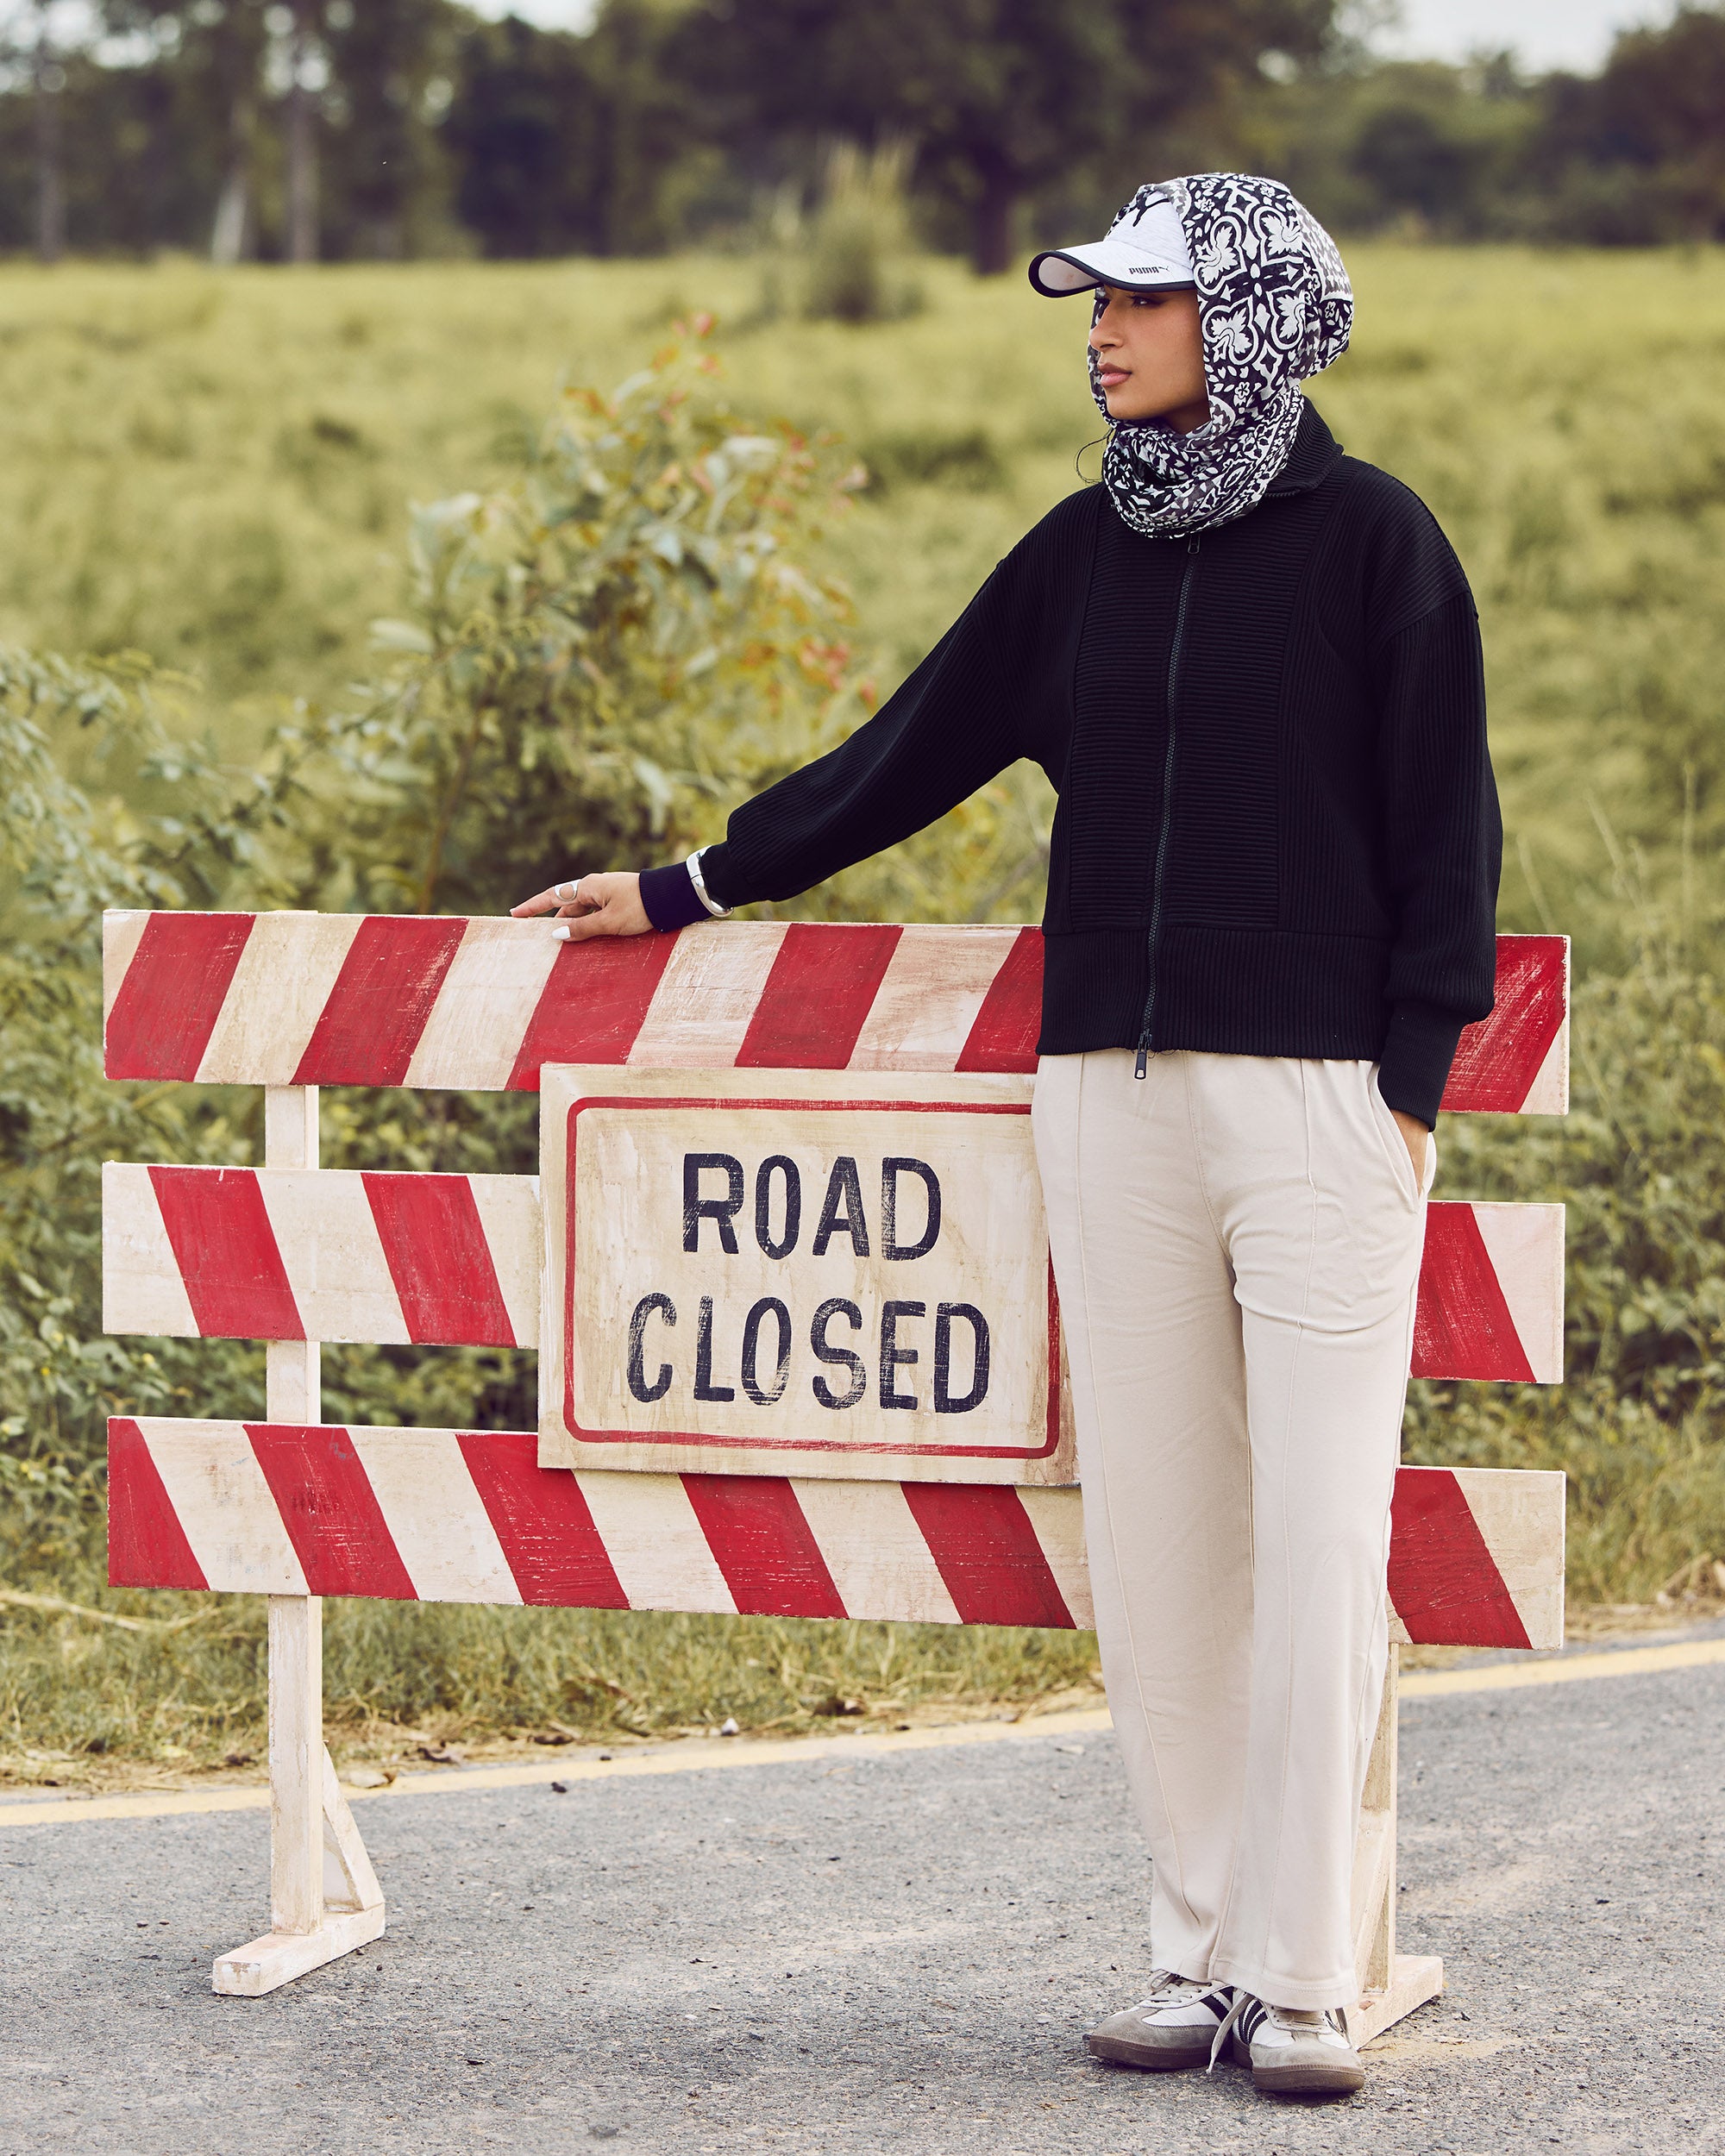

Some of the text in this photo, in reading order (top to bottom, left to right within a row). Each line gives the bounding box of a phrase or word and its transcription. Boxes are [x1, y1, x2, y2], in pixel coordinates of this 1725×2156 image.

[1128, 266, 1159, 274] PUMA
[682, 1153, 941, 1261] ROAD
[627, 1292, 989, 1413] CLOSED
